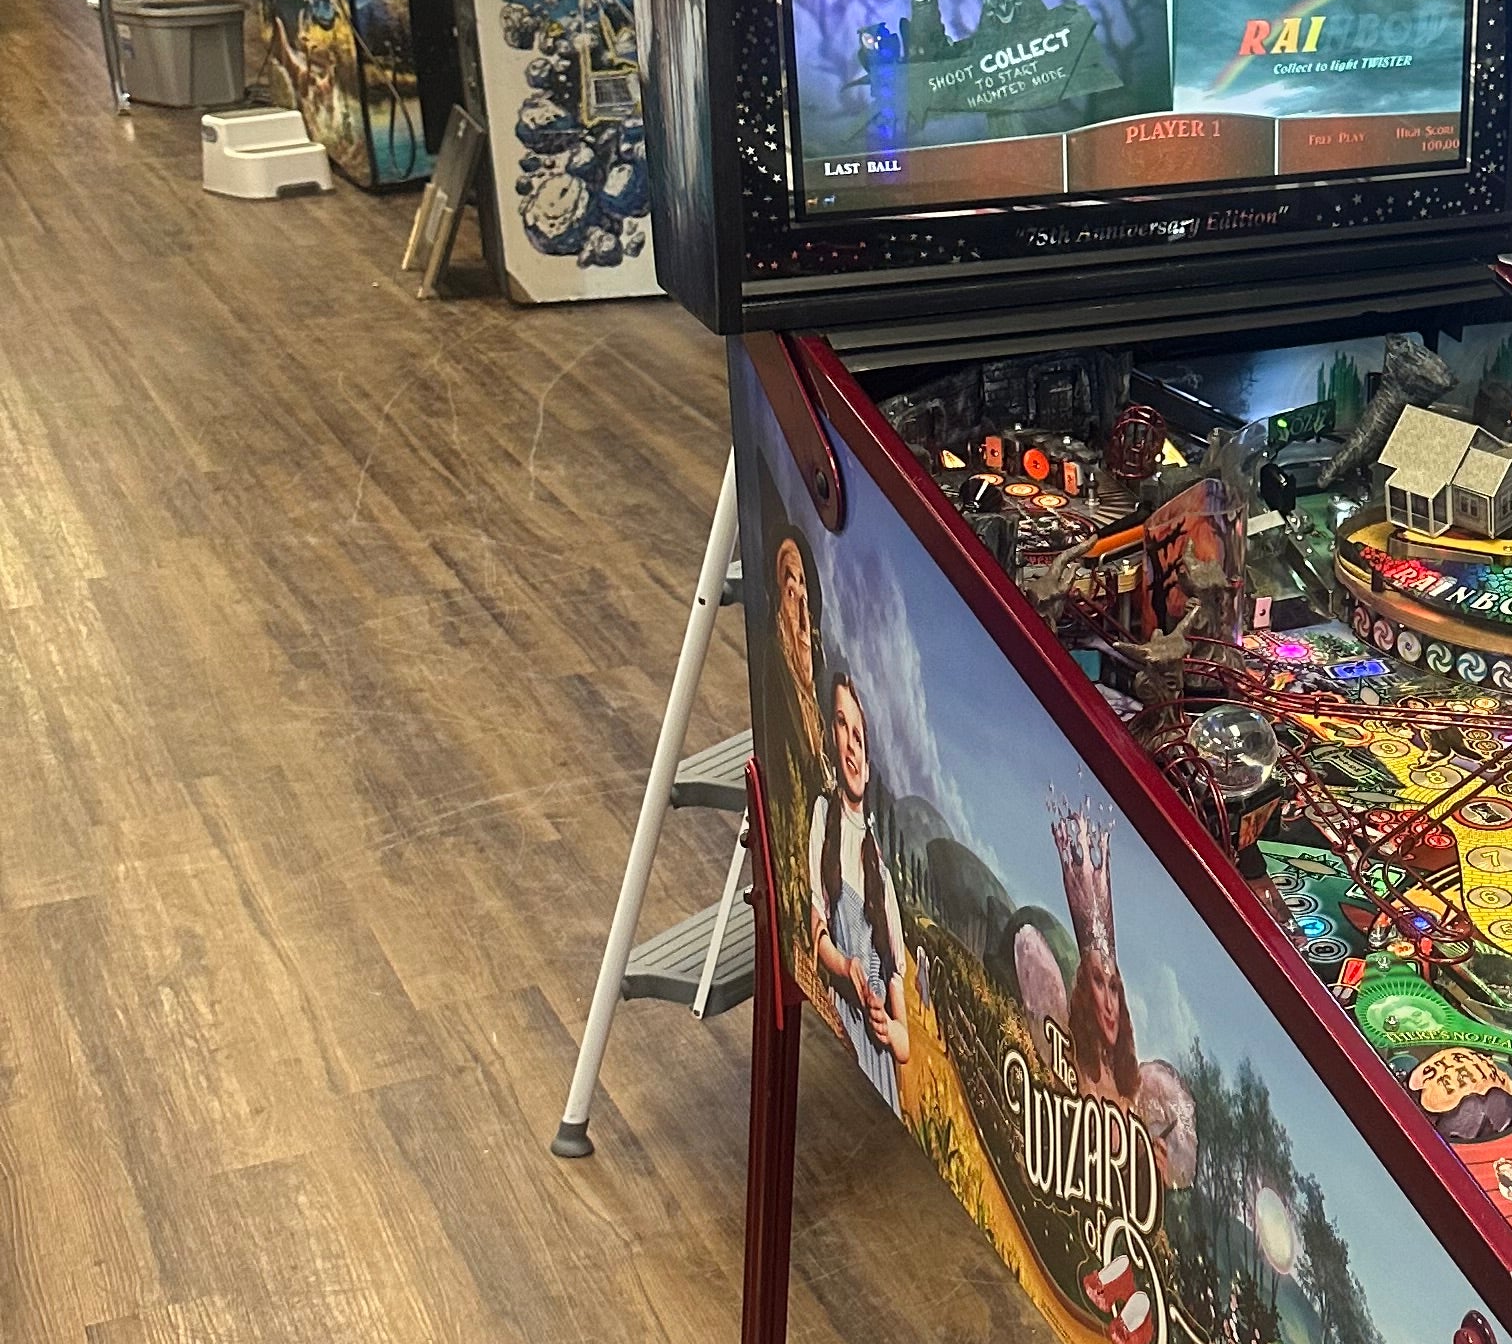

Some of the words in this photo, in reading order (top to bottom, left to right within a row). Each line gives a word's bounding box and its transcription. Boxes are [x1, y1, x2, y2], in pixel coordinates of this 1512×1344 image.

[928, 64, 974, 93] SHOOT
[979, 28, 1071, 73] COLLECT
[1273, 62, 1313, 76] Collect
[1315, 61, 1328, 72] to
[1330, 58, 1359, 73] light
[1361, 55, 1414, 69] TWISTER
[967, 81, 1027, 108] HAUNTED
[1031, 66, 1067, 88] MODE
[975, 76, 994, 91] TO
[998, 60, 1039, 84] START
[1124, 119, 1206, 144] PLAYER
[1211, 119, 1222, 138] 1
[824, 161, 861, 176] LAST
[866, 160, 902, 173] BALL
[1426, 770, 1447, 785] 8
[1481, 850, 1501, 868] 7
[1479, 889, 1500, 905] 6
[1452, 1032, 1480, 1043] NO
[1044, 1016, 1078, 1096] The
[1003, 1049, 1160, 1236] WIZARD
[1083, 1208, 1107, 1259] of
